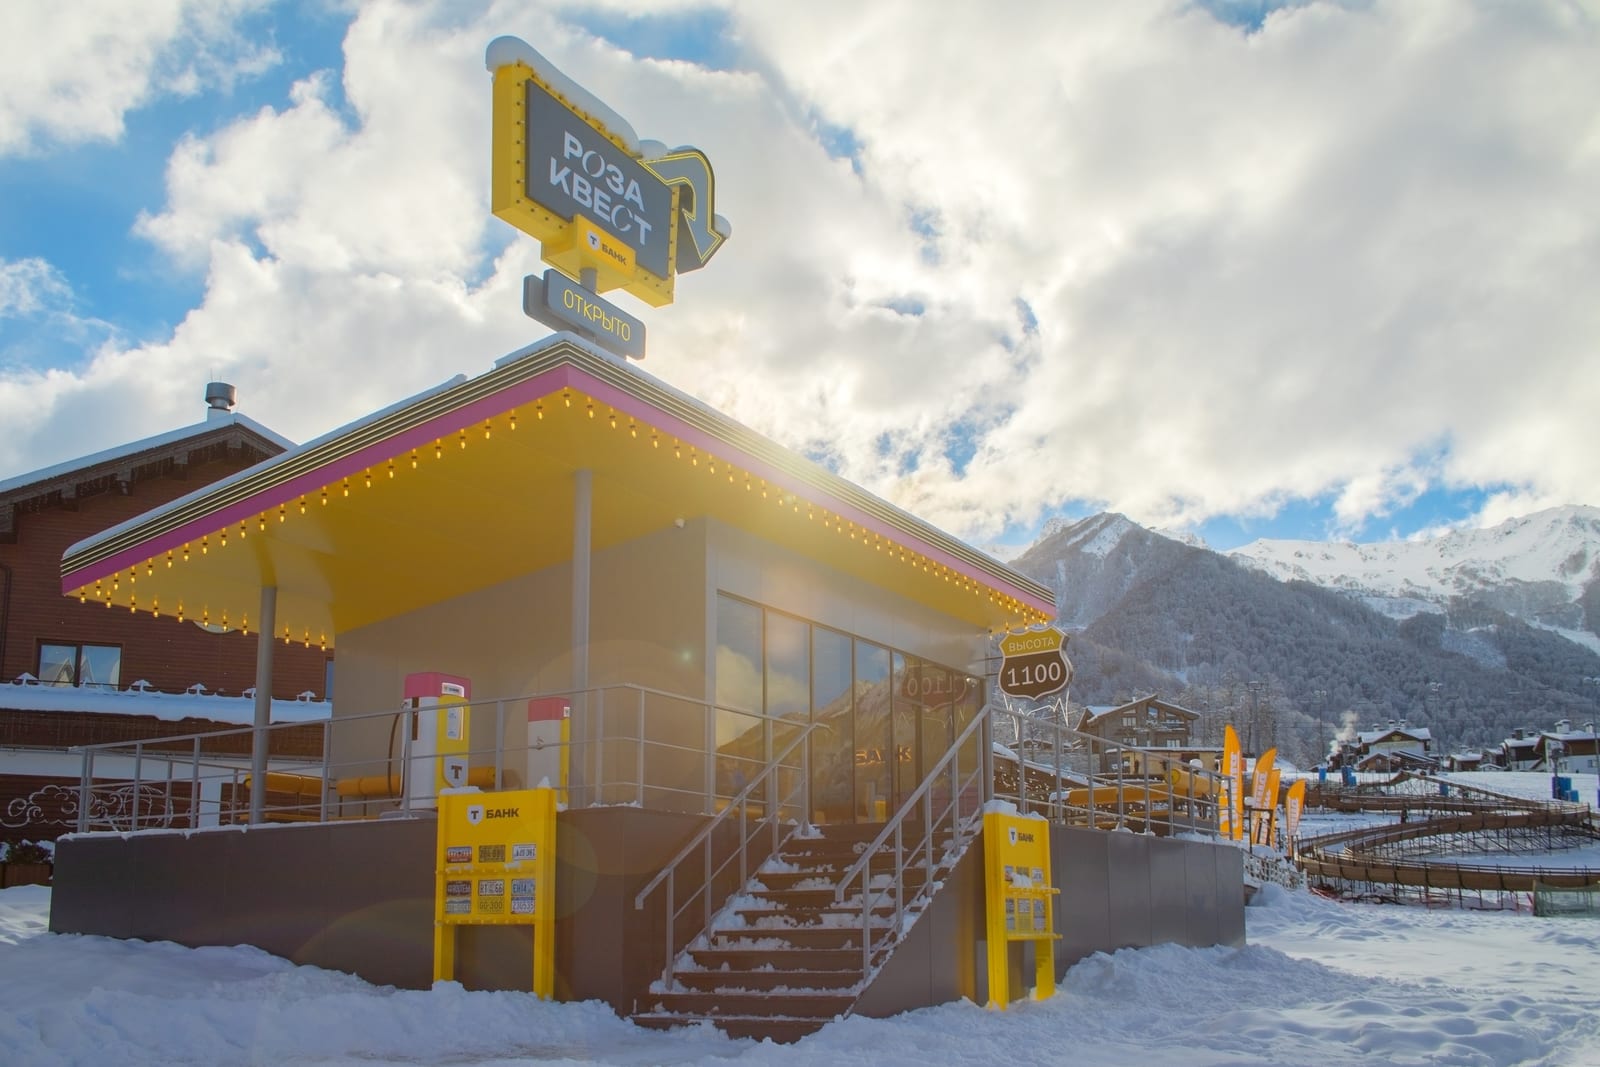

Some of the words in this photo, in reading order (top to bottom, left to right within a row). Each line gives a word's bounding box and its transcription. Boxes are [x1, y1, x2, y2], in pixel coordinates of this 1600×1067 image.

[563, 131, 645, 212] РОЗА
[549, 157, 653, 246] КВЕСТ
[601, 243, 627, 267] БАНК
[563, 289, 631, 342] ОТКРЫТО
[1008, 637, 1055, 652] ВЫСОТА
[1007, 662, 1061, 687] 1100
[486, 807, 519, 820] БАНК
